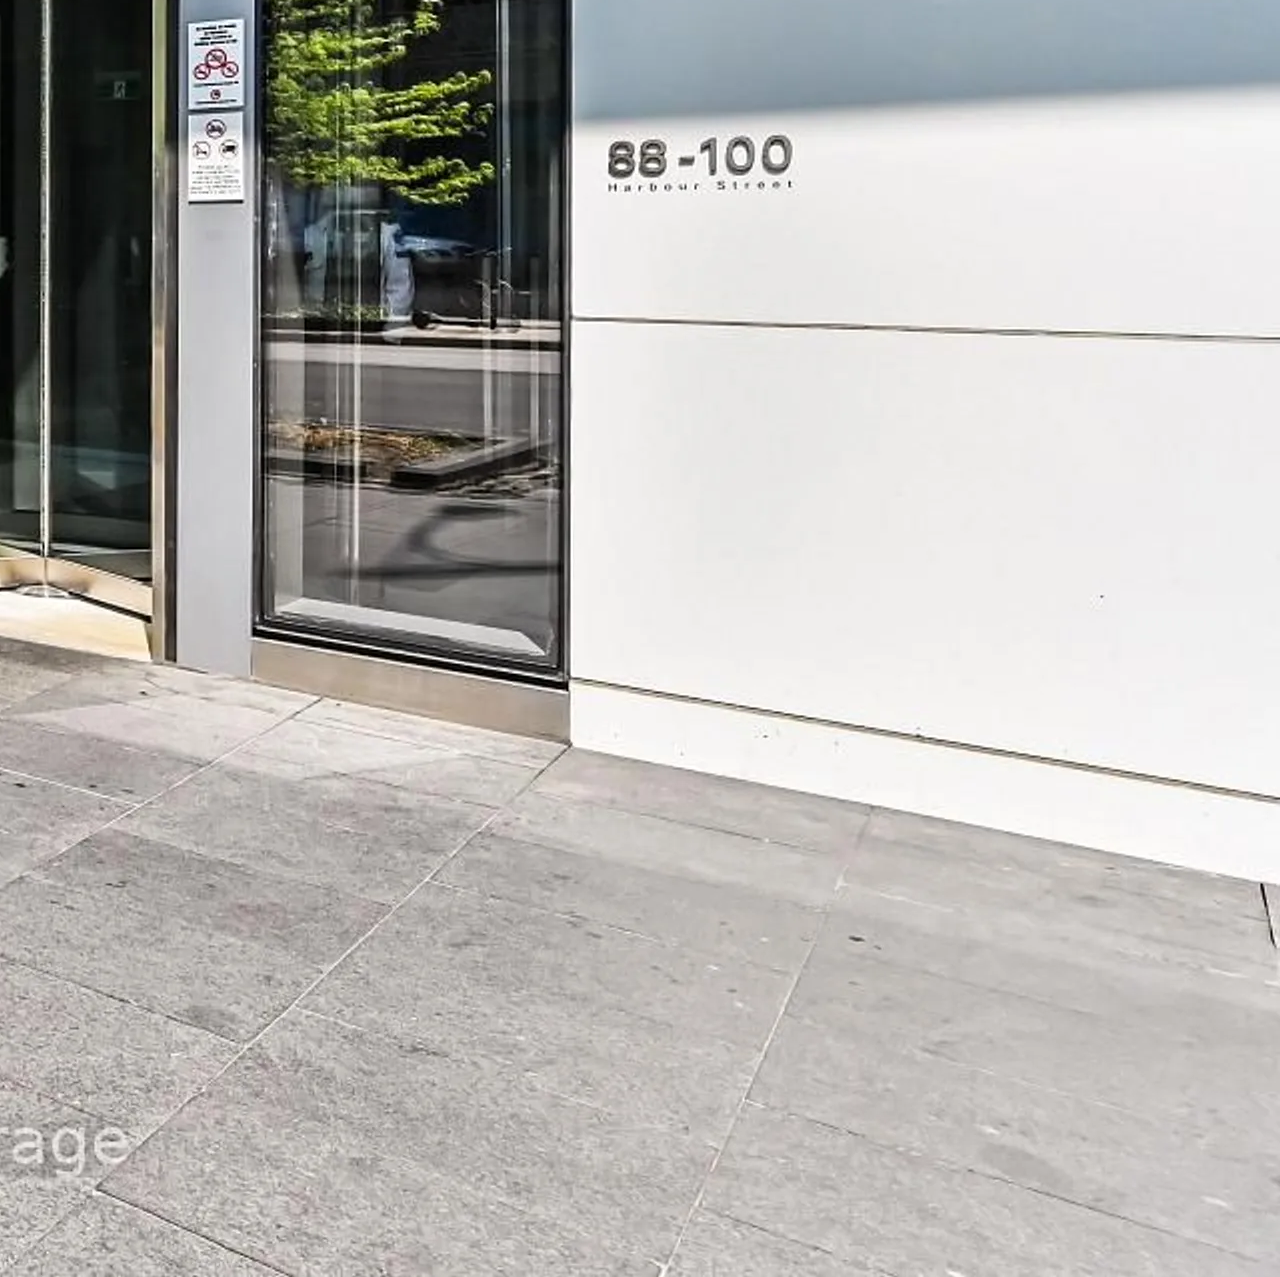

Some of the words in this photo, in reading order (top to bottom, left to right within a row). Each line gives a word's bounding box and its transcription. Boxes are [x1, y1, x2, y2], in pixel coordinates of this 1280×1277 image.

[608, 135, 792, 179] 88-100
[608, 183, 700, 192] Harbour
[717, 180, 792, 190] Street
